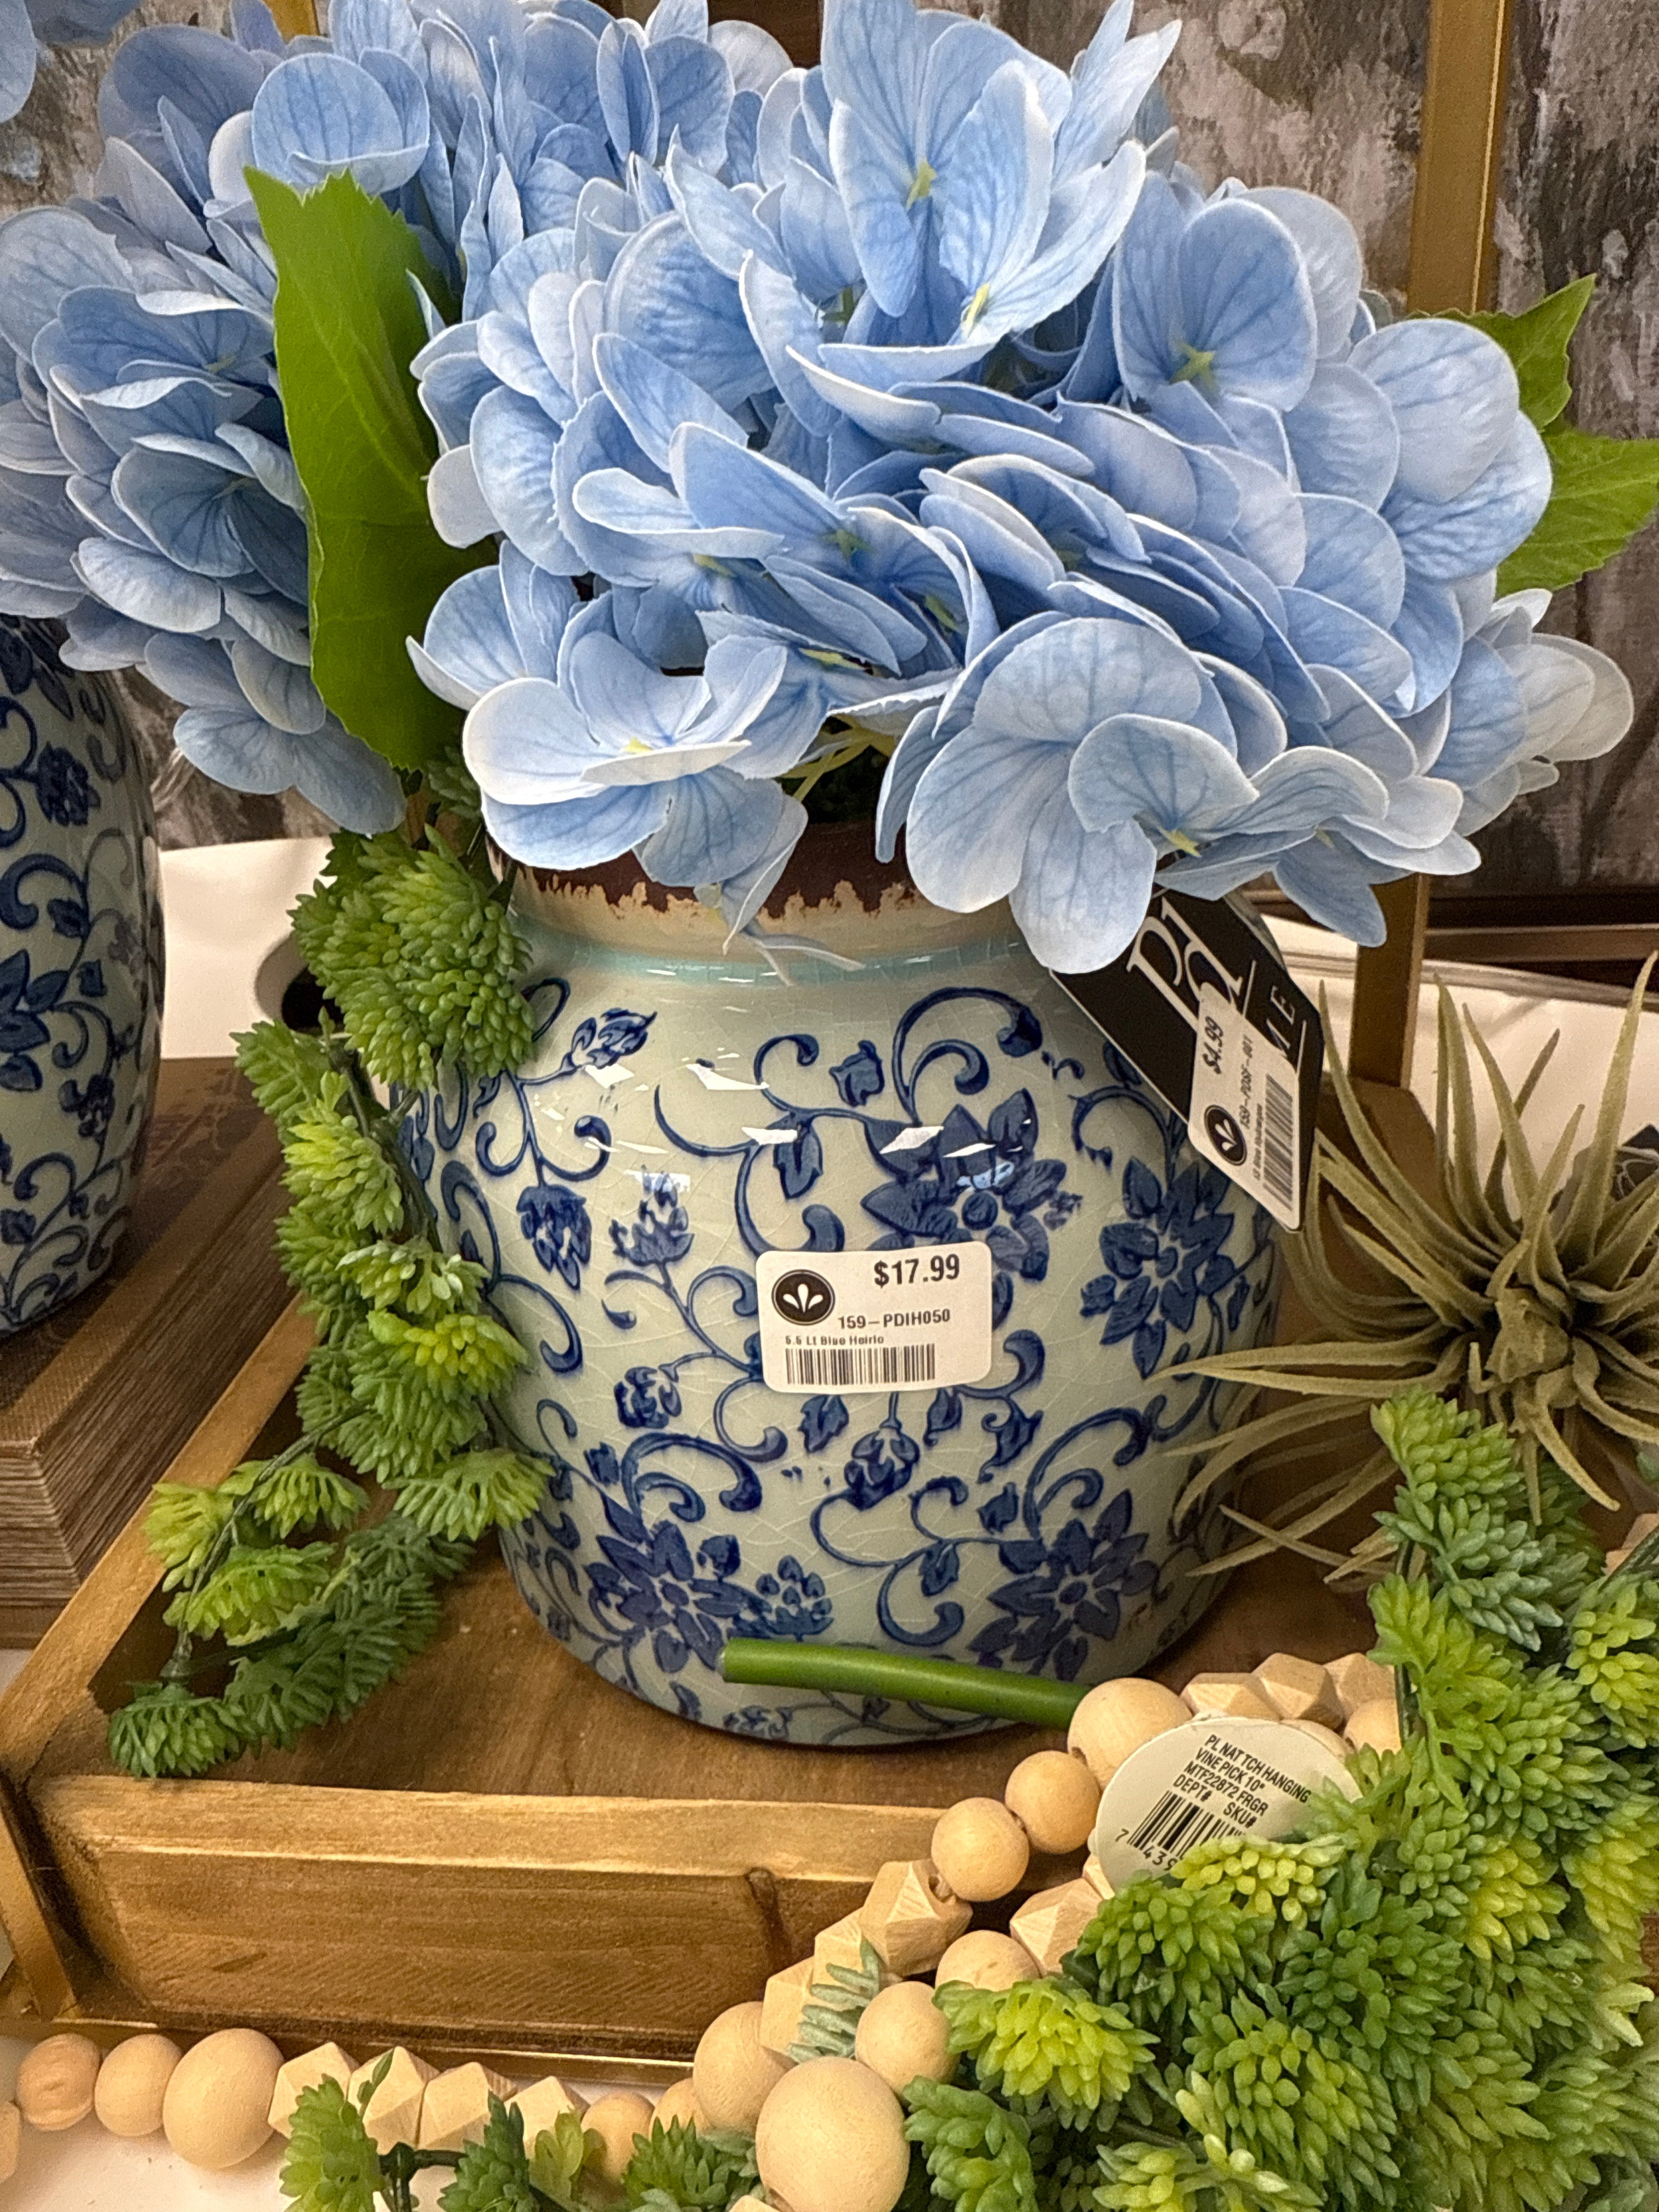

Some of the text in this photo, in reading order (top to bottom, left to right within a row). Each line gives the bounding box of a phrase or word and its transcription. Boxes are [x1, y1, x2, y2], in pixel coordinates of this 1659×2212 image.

[1202, 1016, 1224, 1074] $4.99
[873, 1253, 960, 1289] $17.99
[820, 1335, 846, 1346] Blue
[1183, 1760, 1269, 1817] MTF22872 FRGR
[1195, 1747, 1223, 1769] VINE
[1218, 1760, 1248, 1784] PICK
[1204, 1734, 1312, 1803] PL NAT TCH HANGING
[1172, 1773, 1258, 1829] DEPT# SKU#
